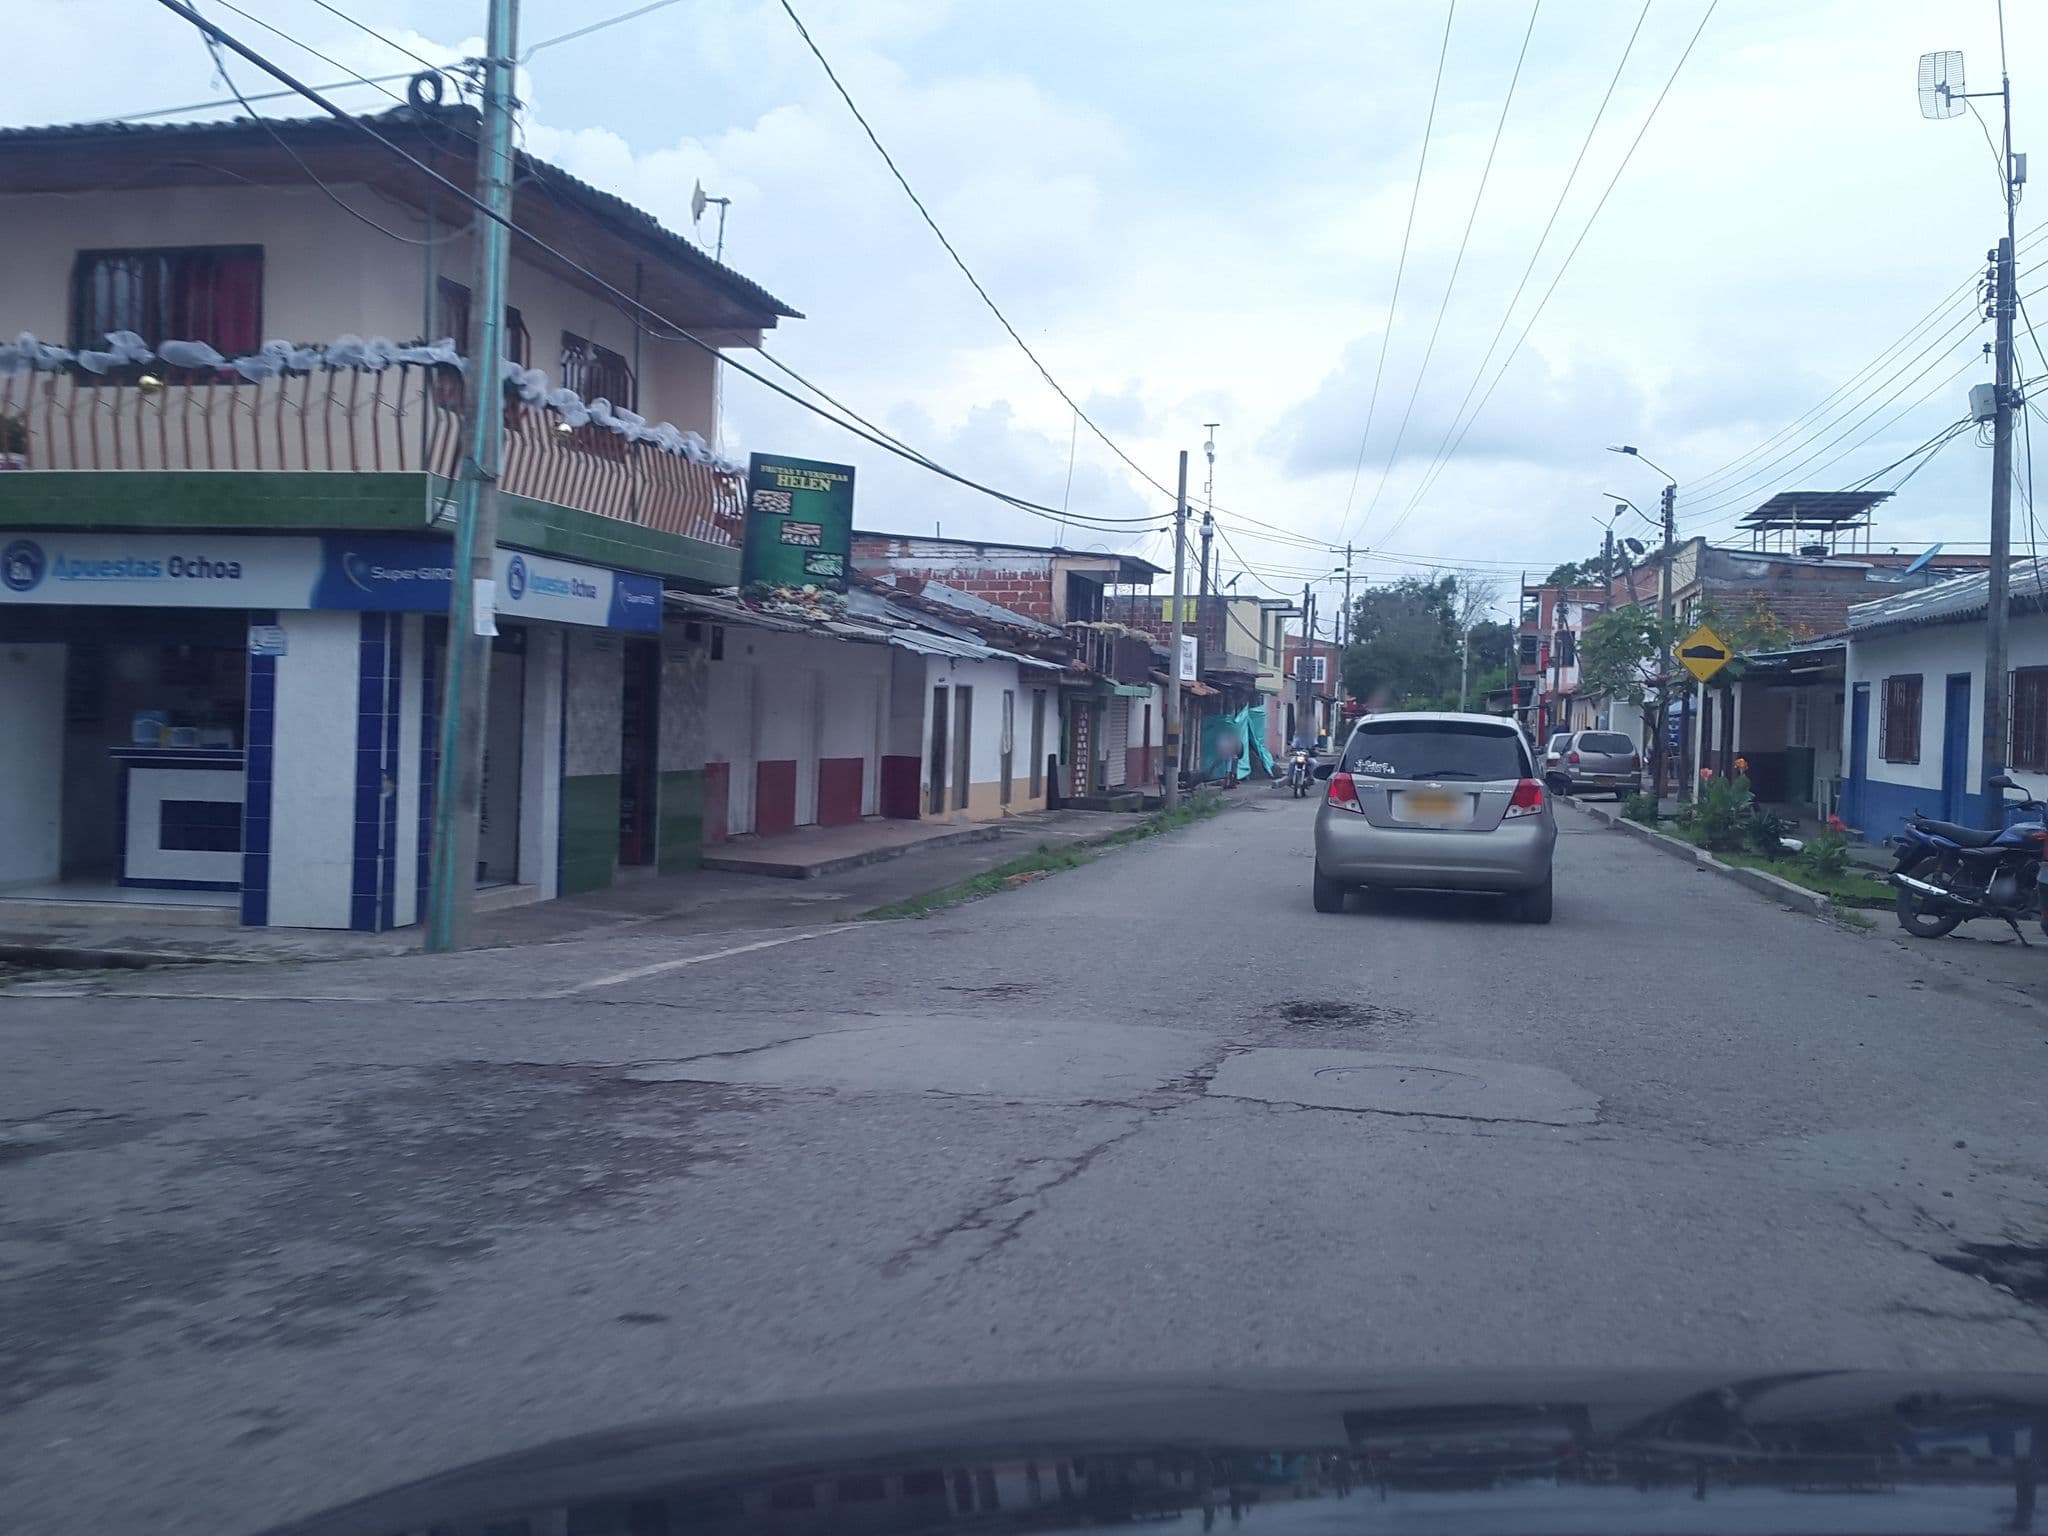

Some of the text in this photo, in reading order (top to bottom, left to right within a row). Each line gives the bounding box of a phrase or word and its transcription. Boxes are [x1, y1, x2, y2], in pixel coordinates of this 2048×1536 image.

[776, 474, 832, 491] HELEN
[51, 553, 242, 579] Apuestas Ochoa
[371, 566, 456, 581] SuperGIRO
